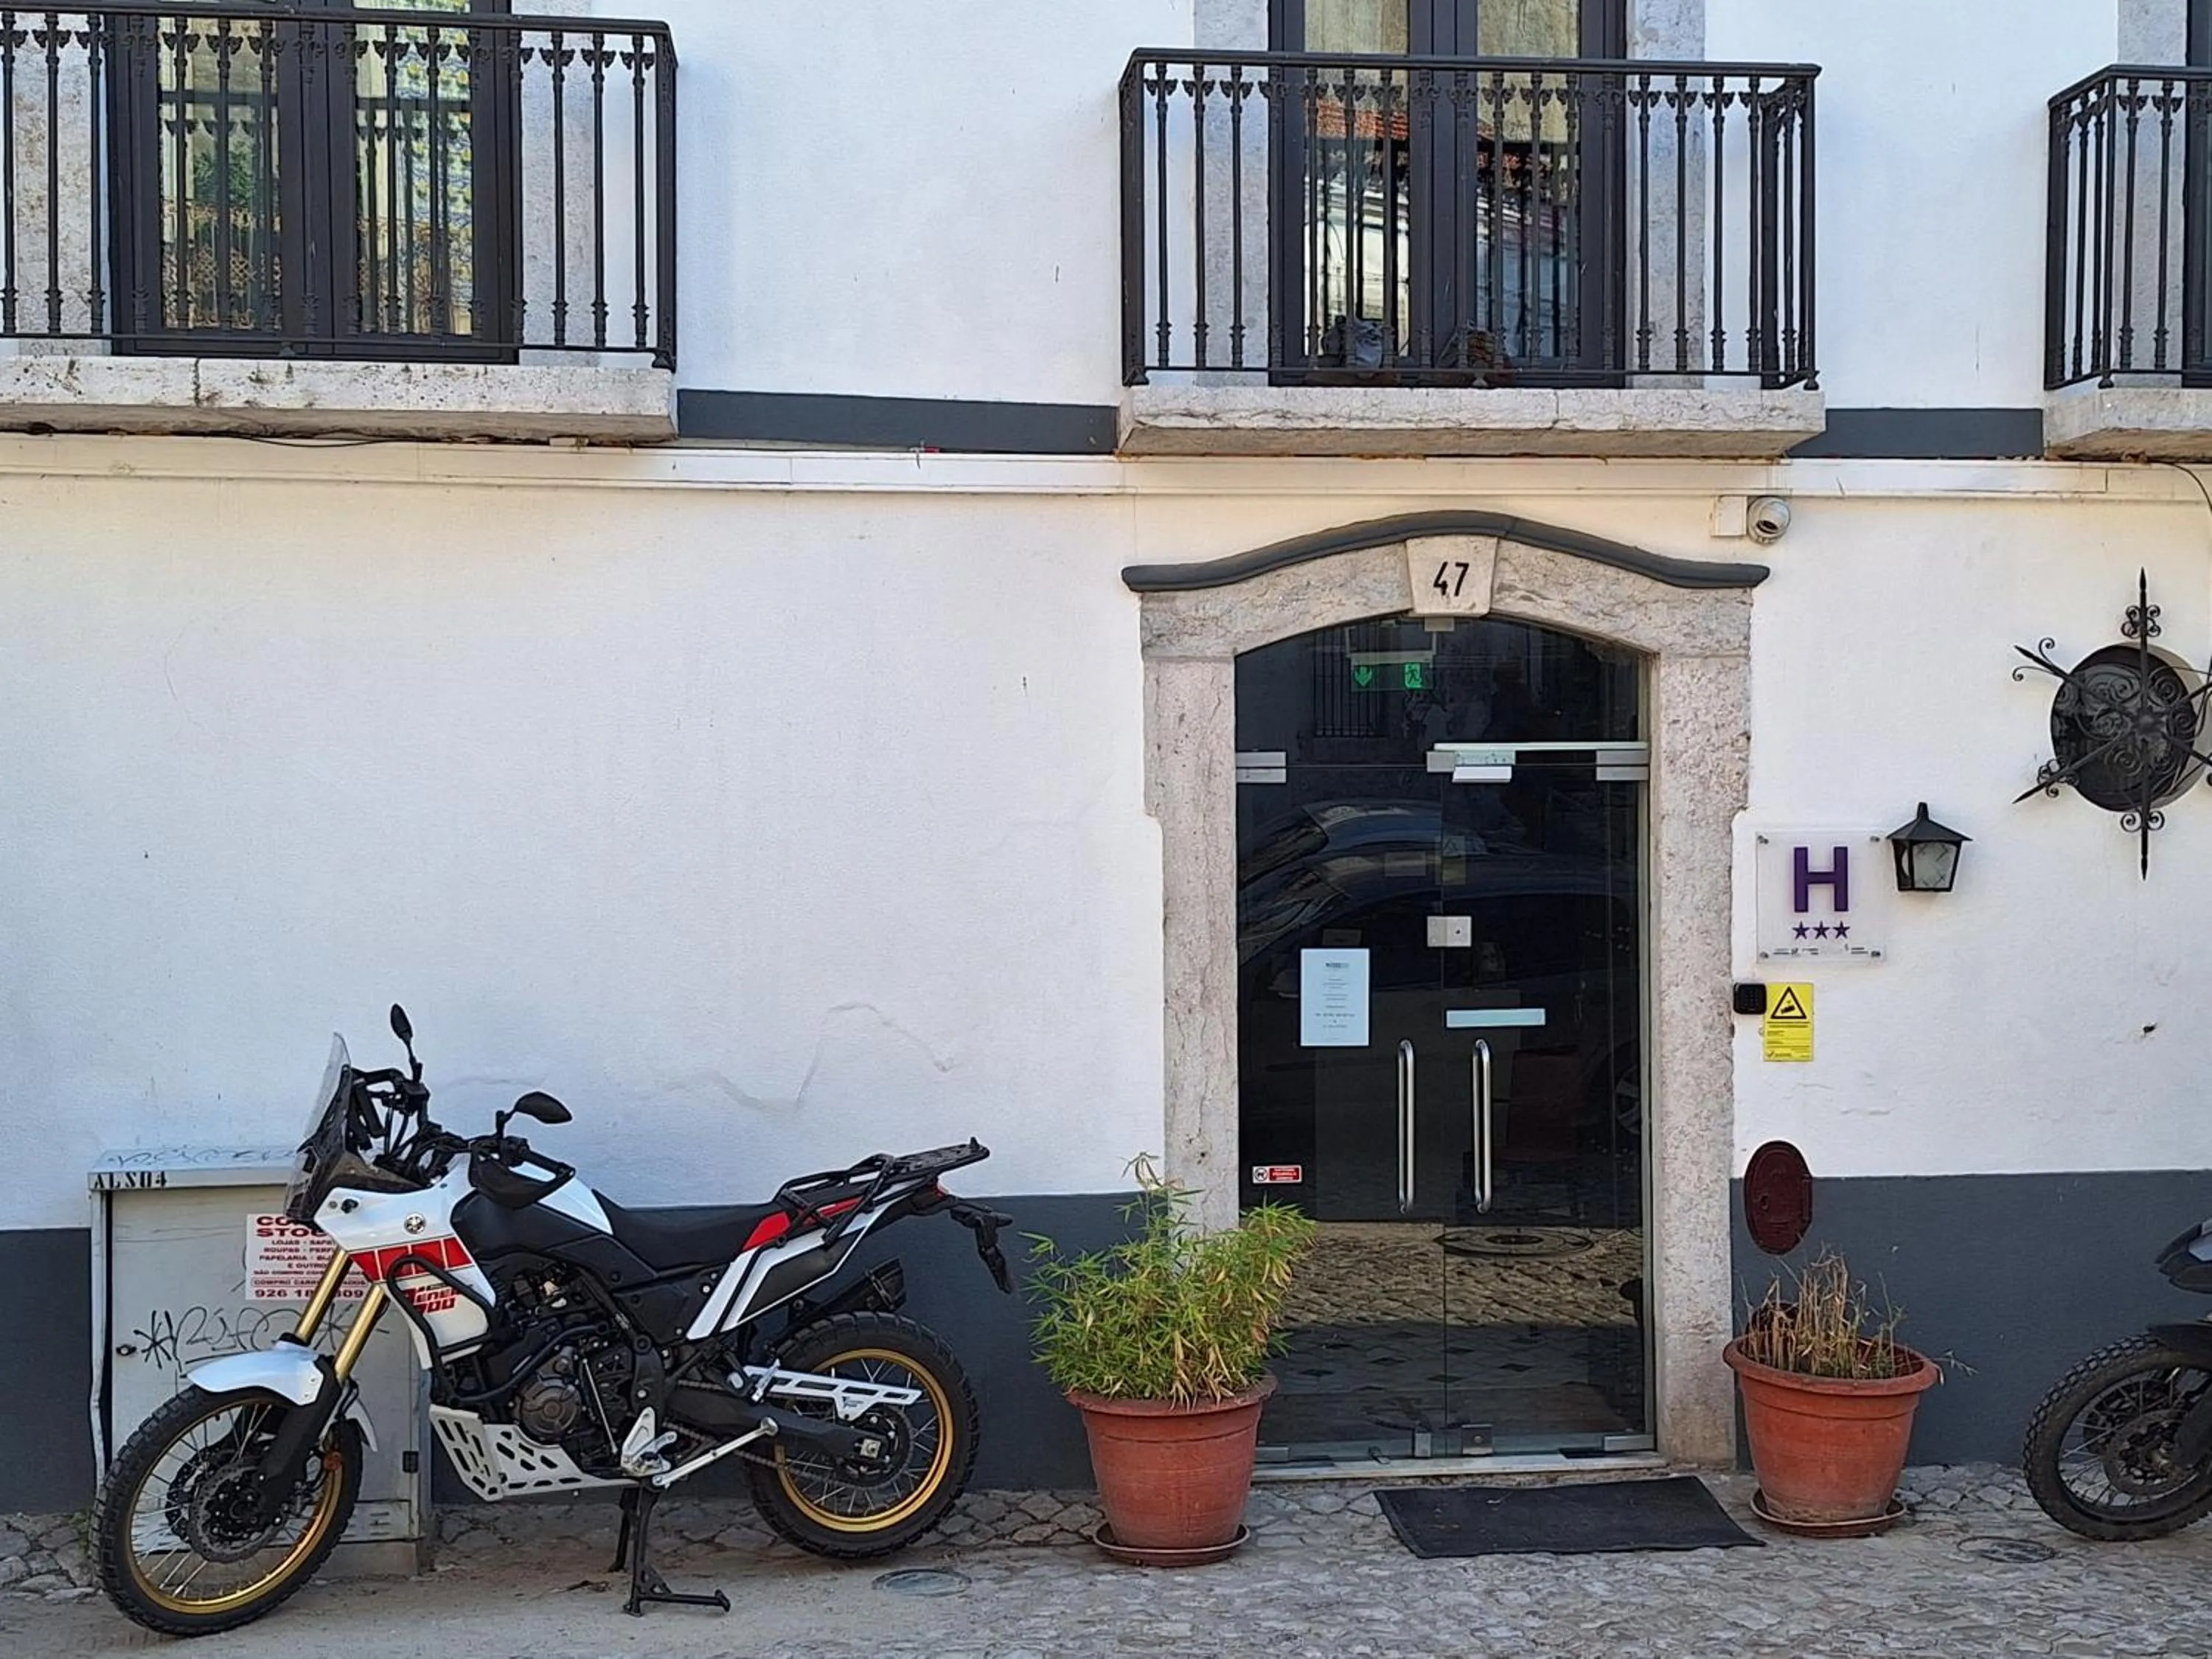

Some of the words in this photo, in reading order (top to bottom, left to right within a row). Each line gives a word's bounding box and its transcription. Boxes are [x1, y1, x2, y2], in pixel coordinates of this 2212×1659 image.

[1433, 560, 1470, 597] 47
[1793, 846, 1849, 913] H
[256, 1228, 327, 1237] STOC
[255, 1289, 288, 1298] 926
